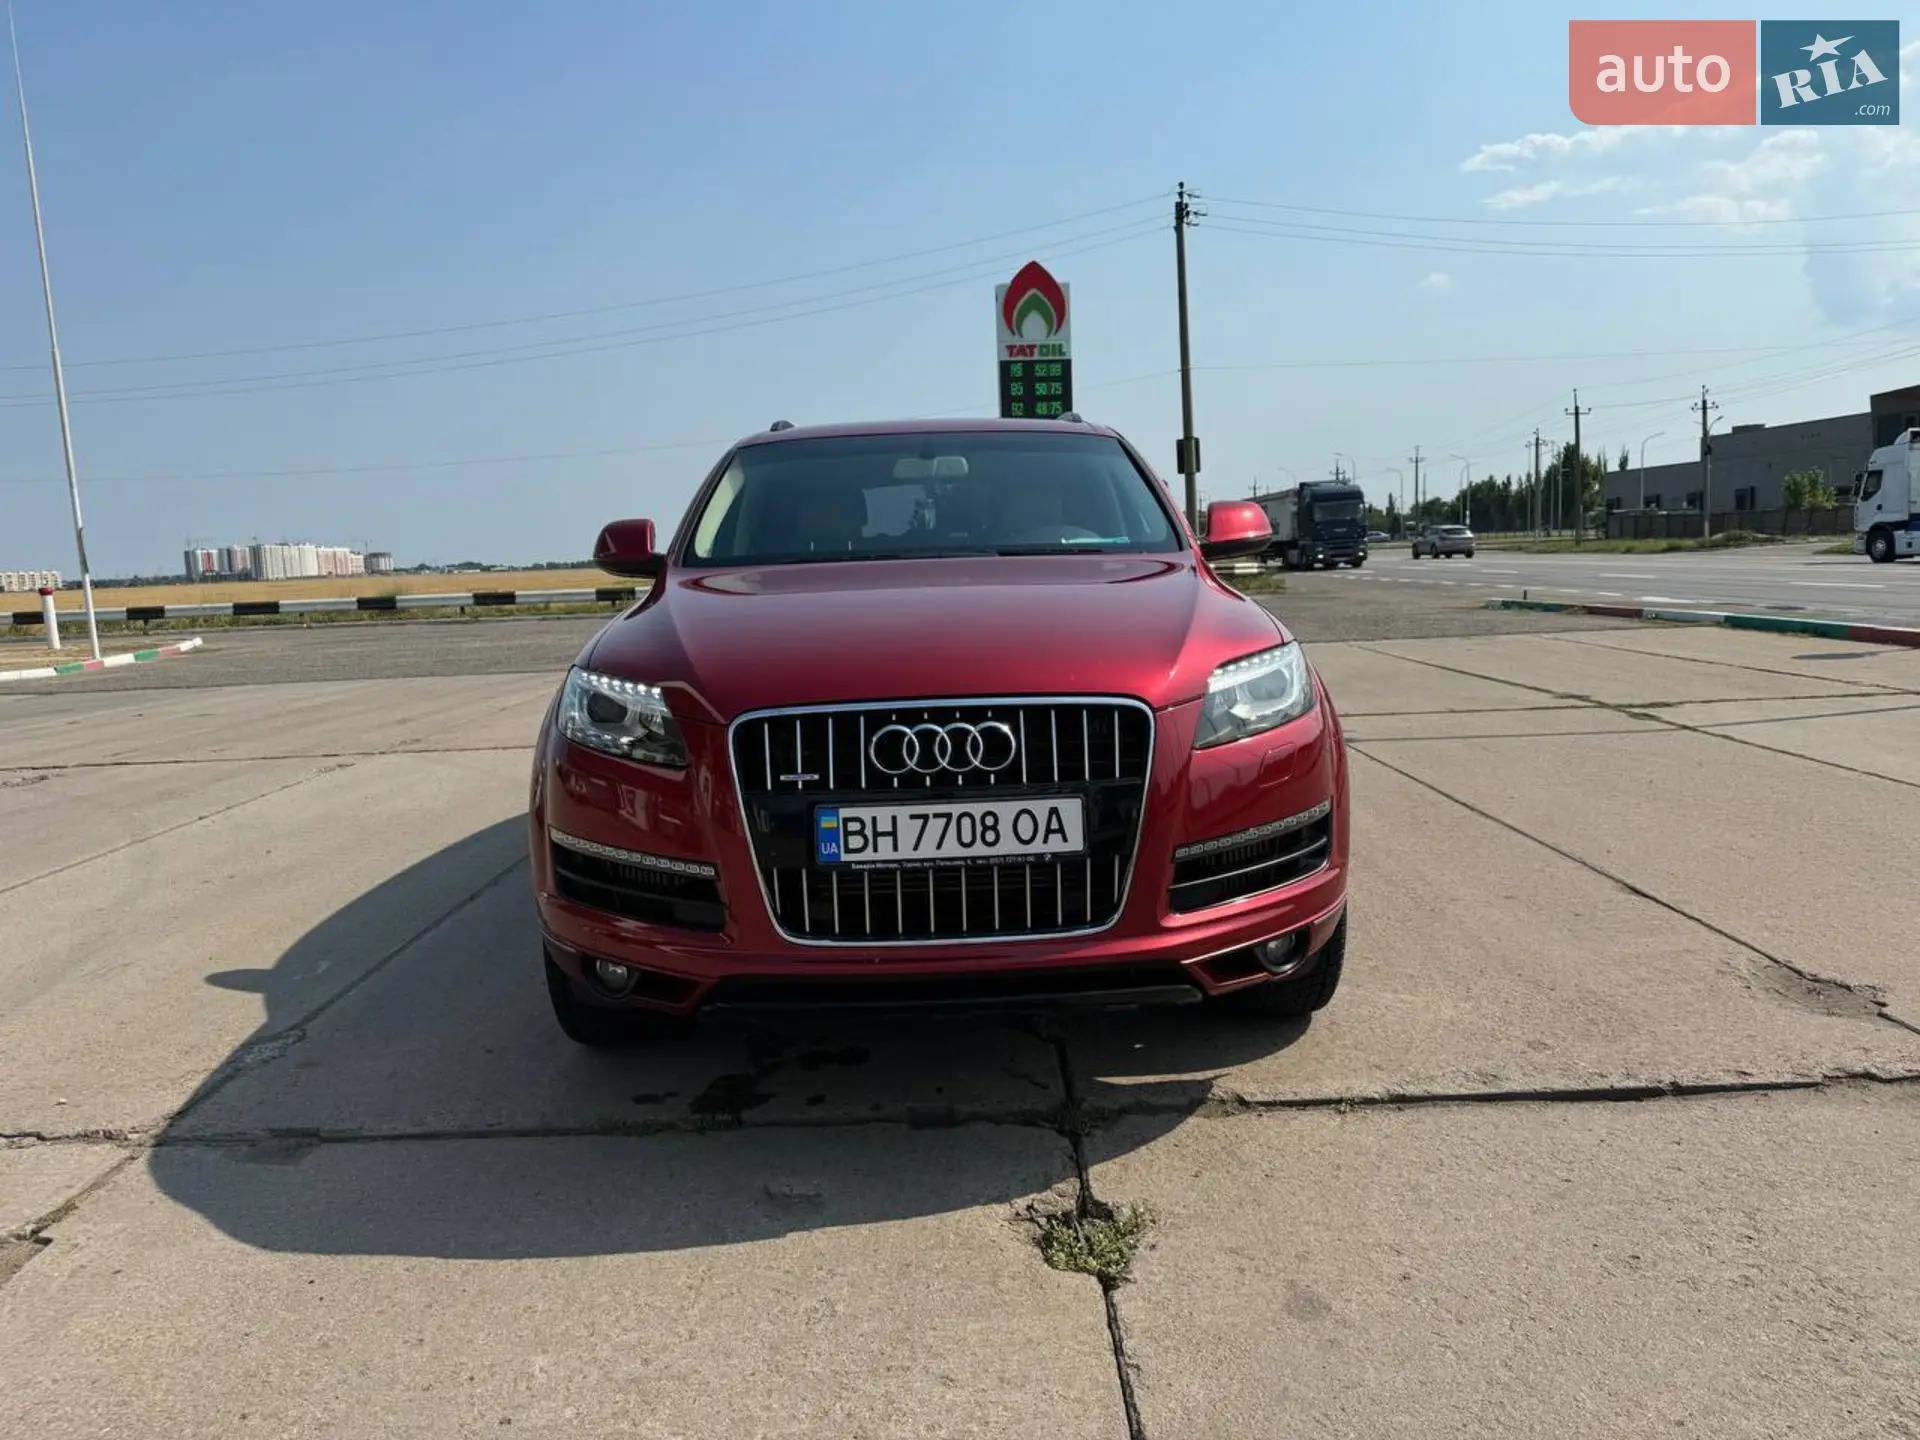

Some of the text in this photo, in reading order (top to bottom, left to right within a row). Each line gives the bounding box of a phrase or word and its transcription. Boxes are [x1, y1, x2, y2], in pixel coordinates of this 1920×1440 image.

[842, 806, 1069, 855] BH 7708 OA
[821, 842, 839, 855] UA
